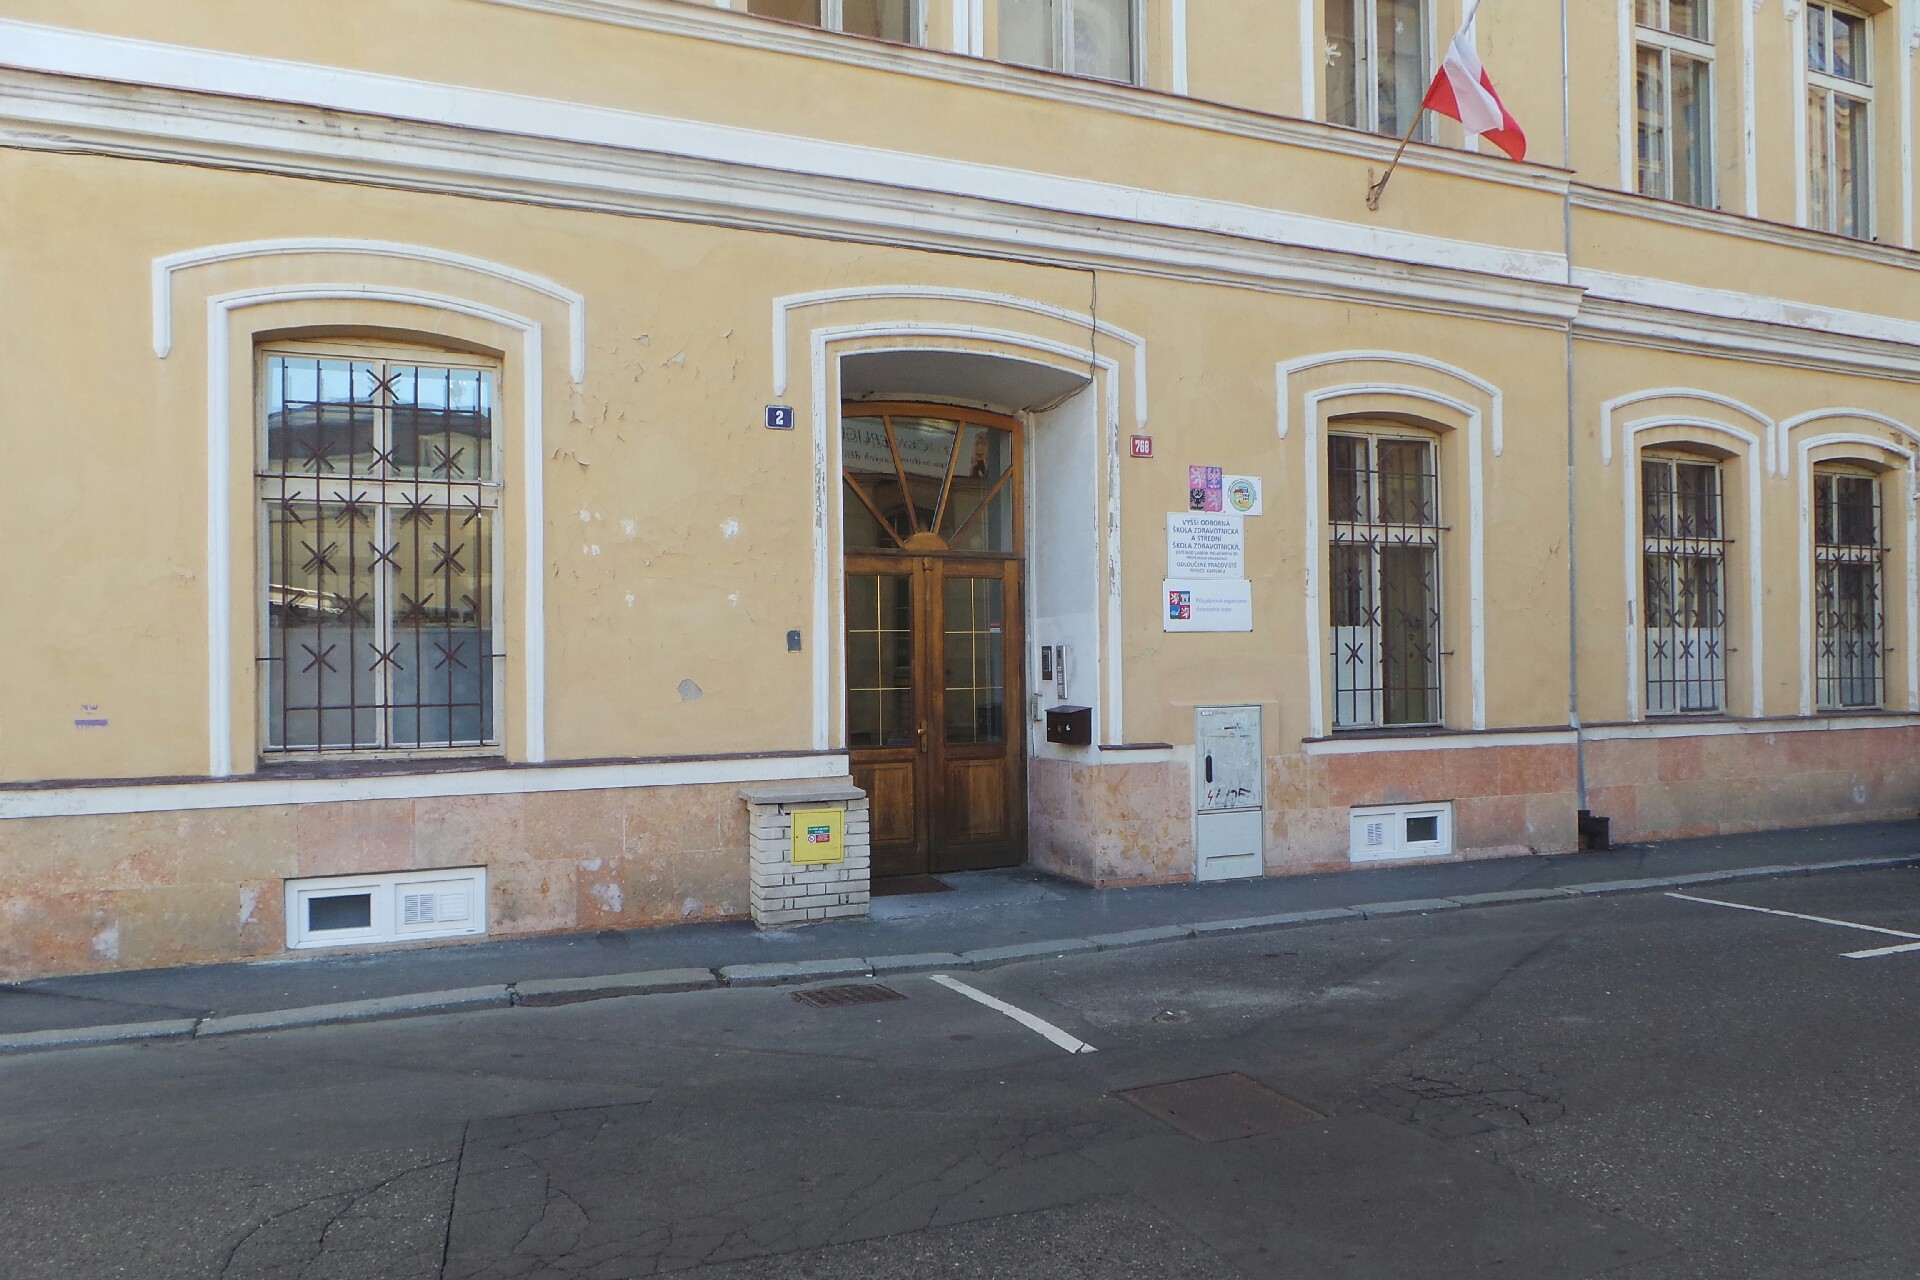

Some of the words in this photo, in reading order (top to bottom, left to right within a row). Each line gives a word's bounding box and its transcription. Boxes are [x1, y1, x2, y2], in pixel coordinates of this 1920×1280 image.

[776, 410, 784, 426] 2
[1134, 439, 1150, 454] 768
[1172, 525, 1193, 534] ŠKOLA
[1172, 541, 1193, 549] ŠKOLA
